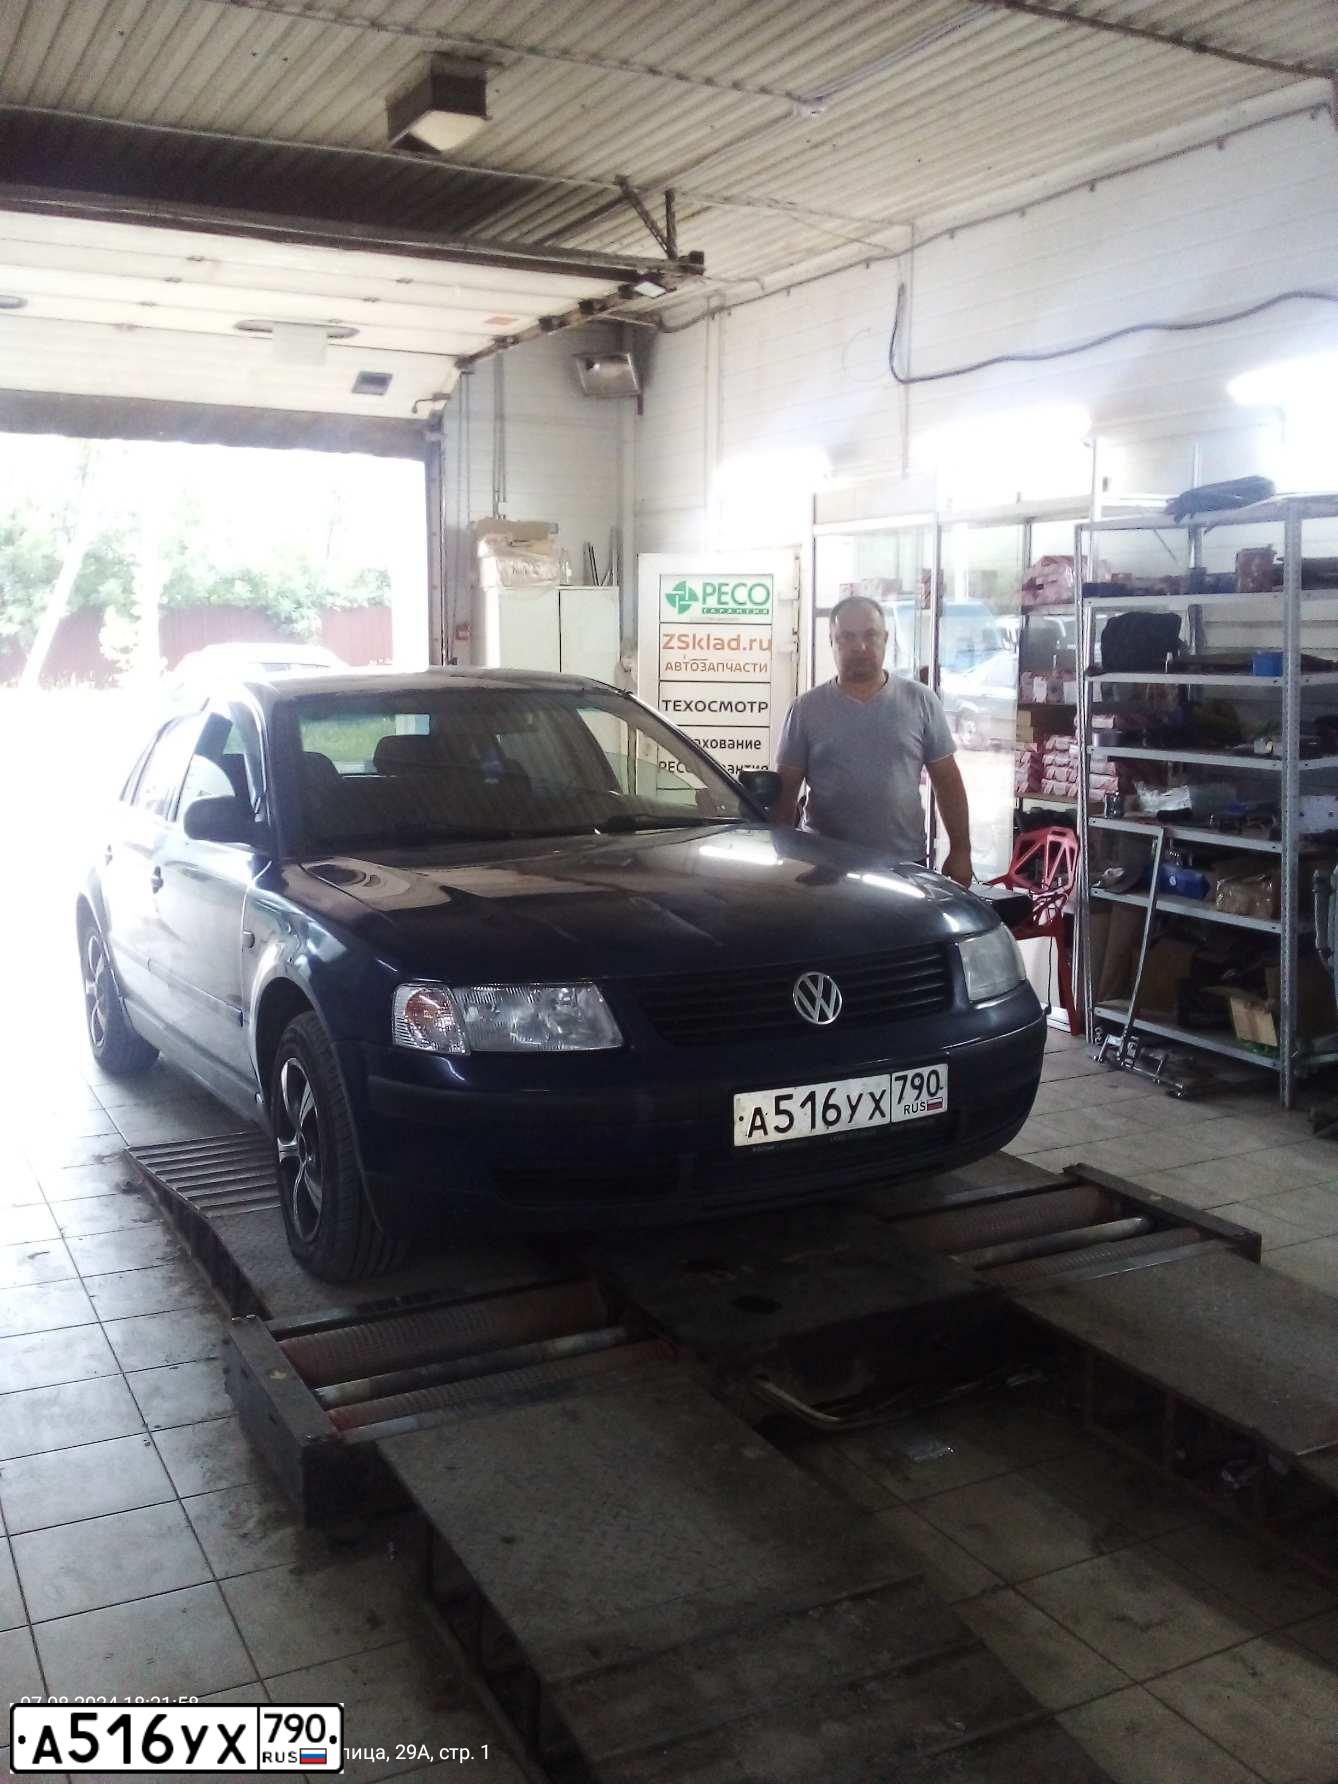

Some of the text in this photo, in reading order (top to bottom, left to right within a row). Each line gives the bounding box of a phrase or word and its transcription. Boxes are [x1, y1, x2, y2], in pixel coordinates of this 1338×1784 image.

[702, 583, 770, 606] РЕСО
[662, 633, 772, 651] ZSklad.ru
[665, 661, 768, 673] АВТОЗАПЧАСТИ
[662, 700, 769, 713] ТЕХОСМОТР
[894, 1069, 941, 1105] 790
[903, 1101, 926, 1115] RUS
